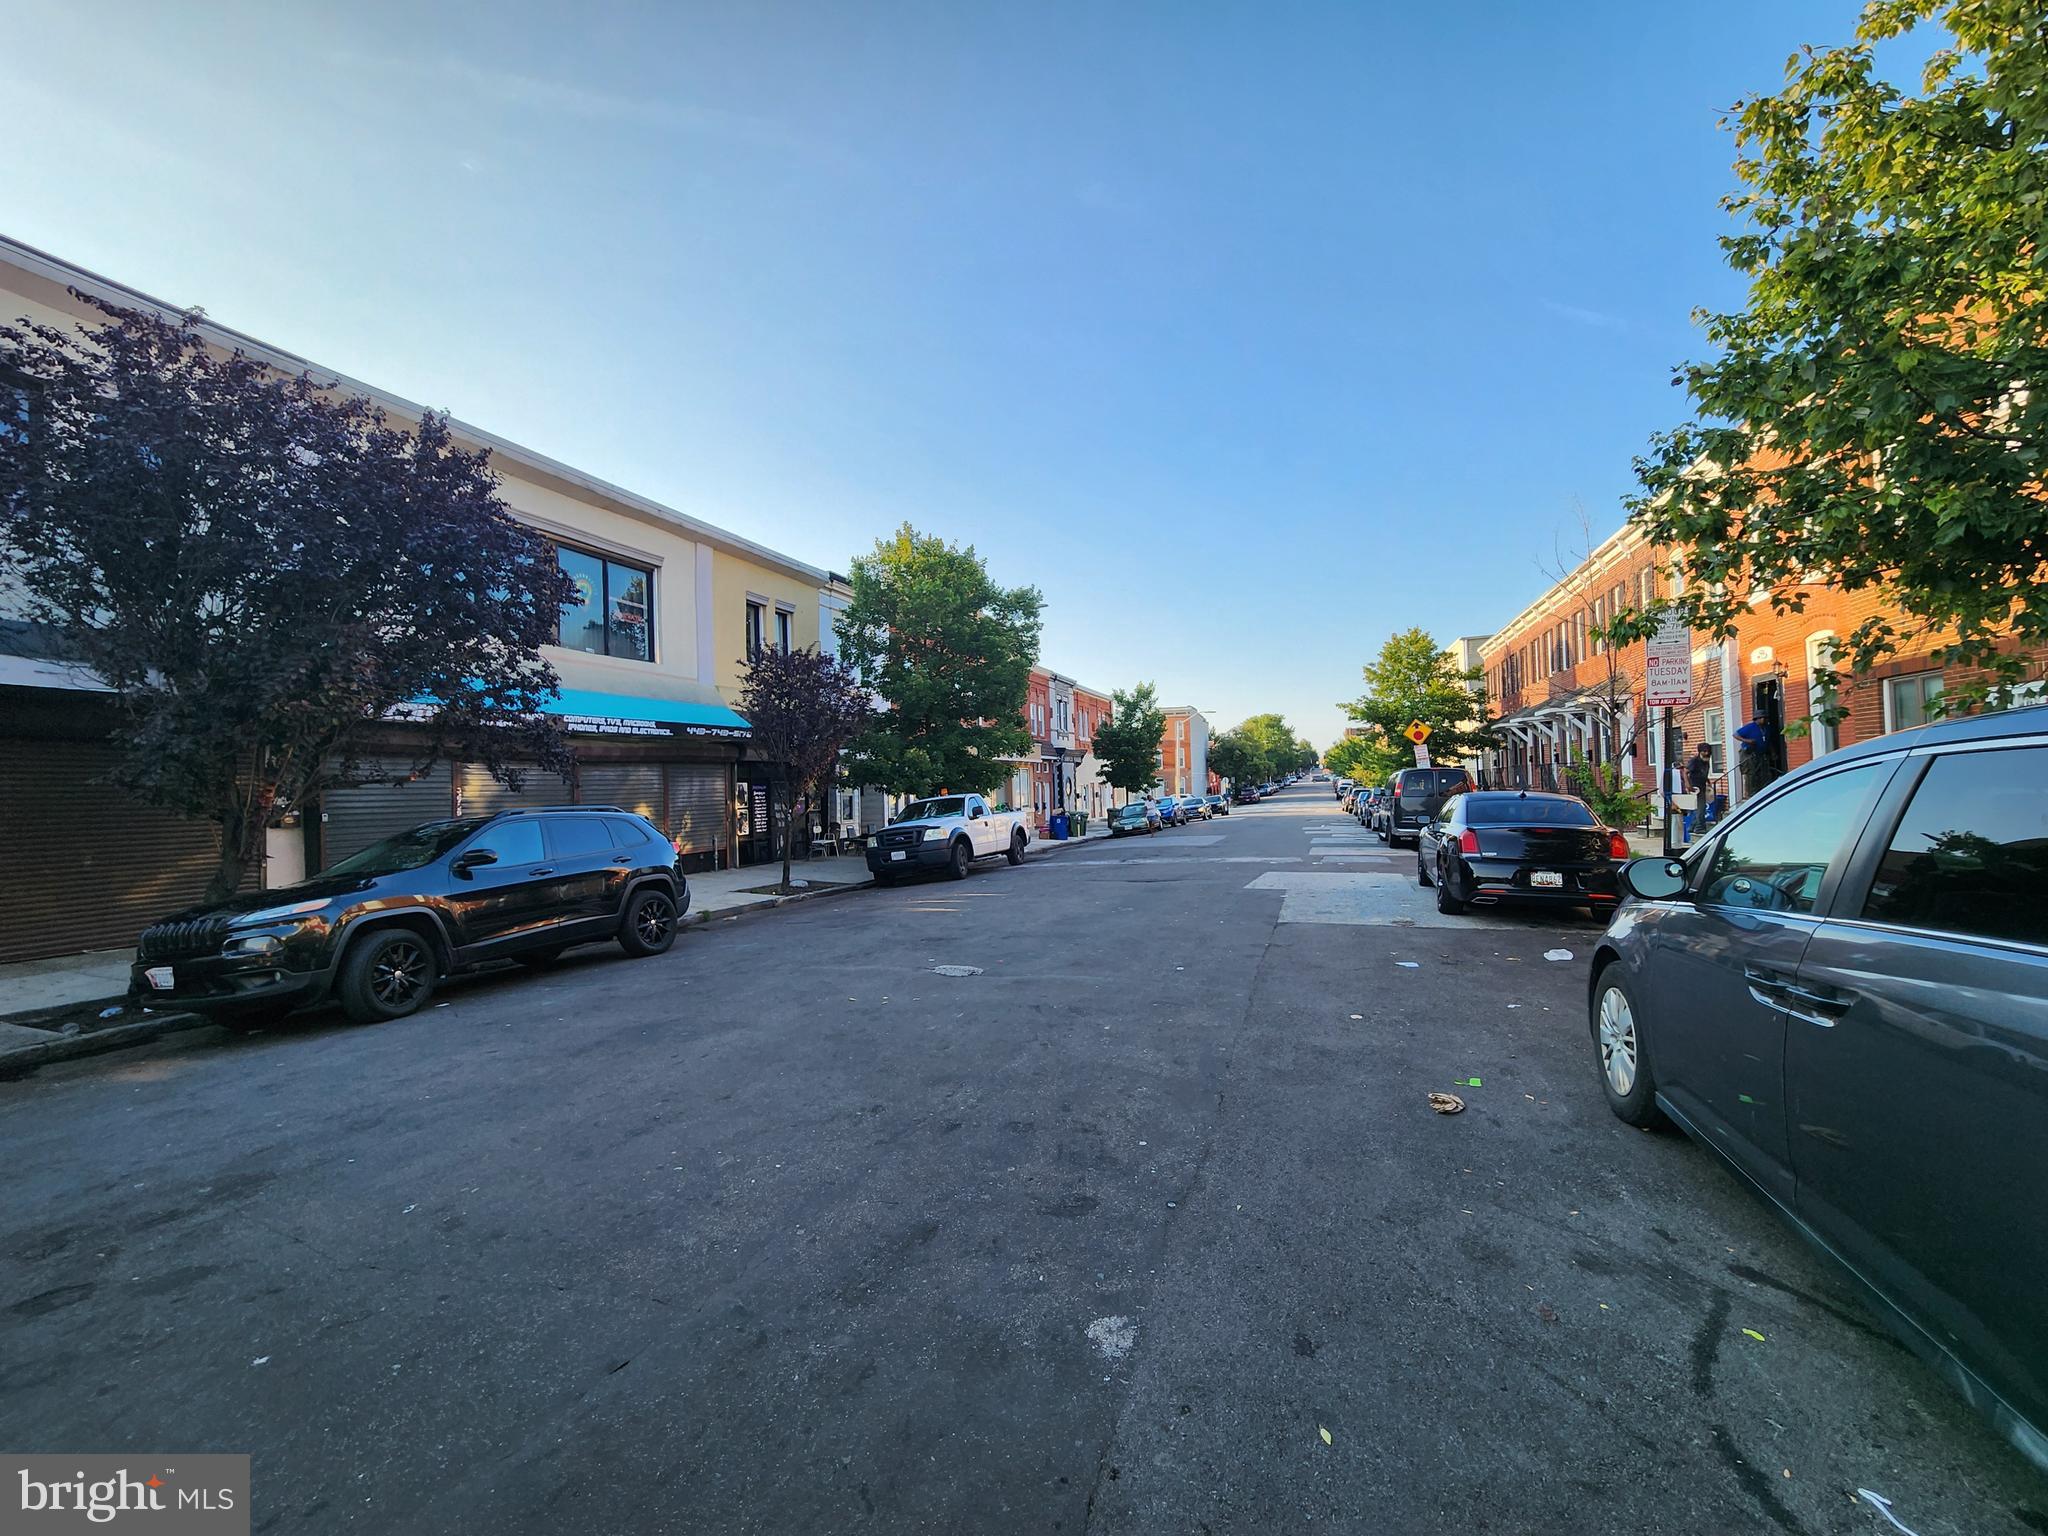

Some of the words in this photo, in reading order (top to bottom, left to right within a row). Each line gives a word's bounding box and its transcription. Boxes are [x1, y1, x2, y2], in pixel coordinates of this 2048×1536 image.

[1648, 658, 1659, 667] NO
[1662, 657, 1689, 665] PARKING
[1649, 666, 1688, 676] TUESDAY
